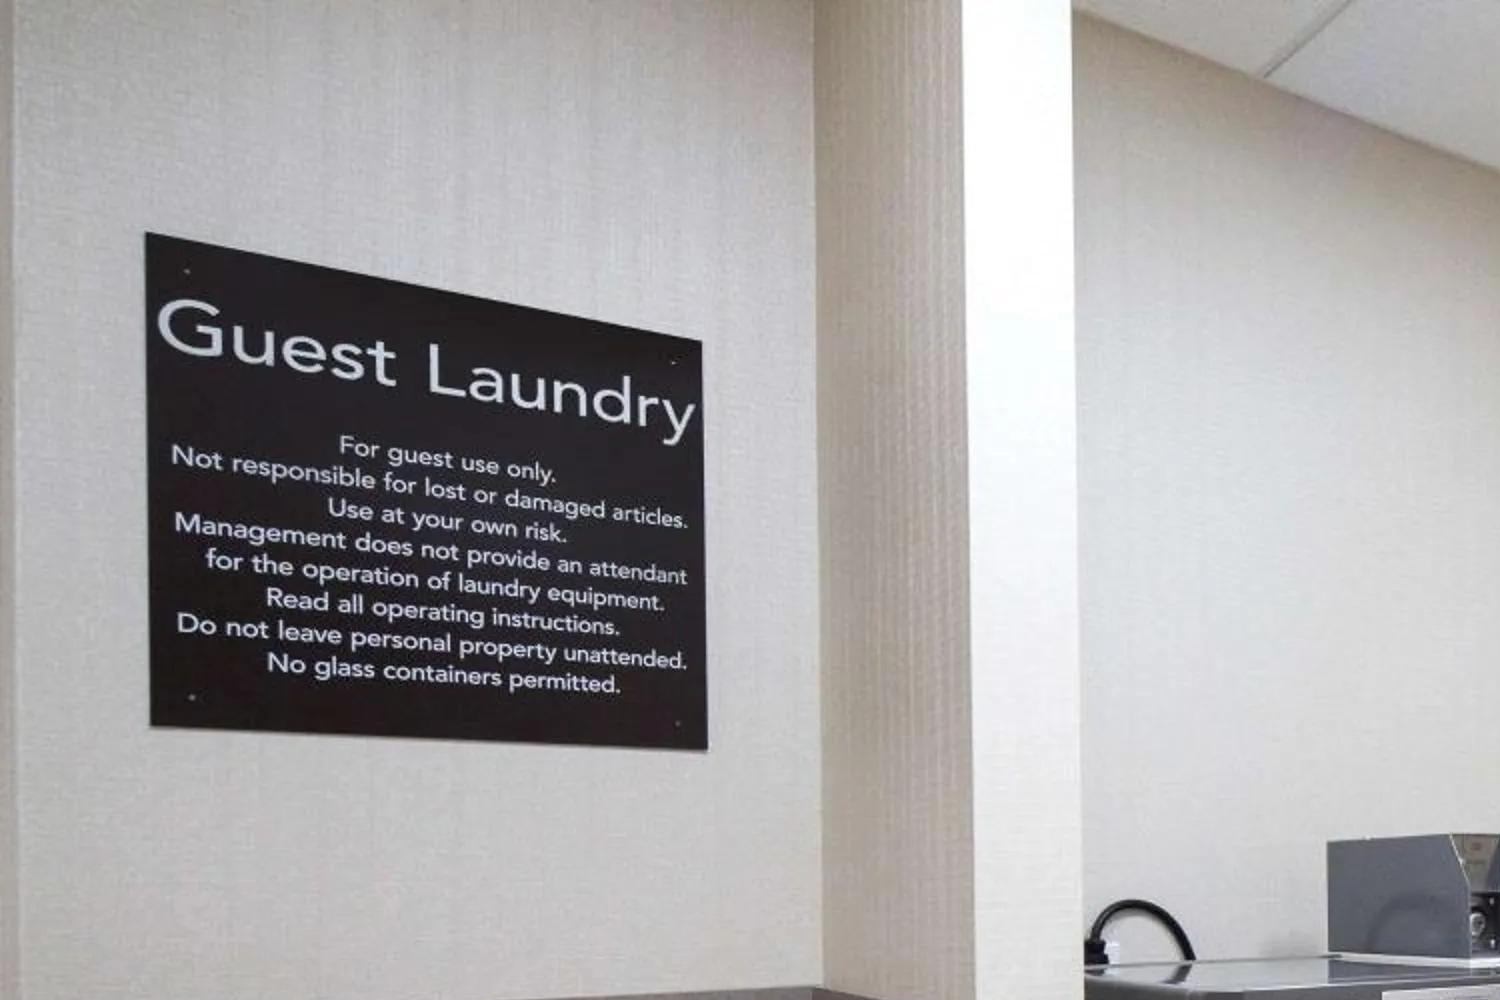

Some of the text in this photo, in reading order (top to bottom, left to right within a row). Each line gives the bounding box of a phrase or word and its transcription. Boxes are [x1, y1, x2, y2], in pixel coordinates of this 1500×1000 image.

[157, 299, 696, 446] Guest Laundry
[172, 444, 688, 529] Not responsible for lost or damaged articles.
[340, 435, 556, 487] For guest use only.
[175, 511, 688, 585] Management does not provide an attendant
[328, 497, 567, 543] Use at your own risk.
[205, 547, 665, 611] for the operation of laundry equipment.
[267, 586, 620, 636] Read all operating instructions.
[177, 612, 687, 670] Do not leave personal property unattended.
[268, 651, 621, 694] No glass containers permitted.
